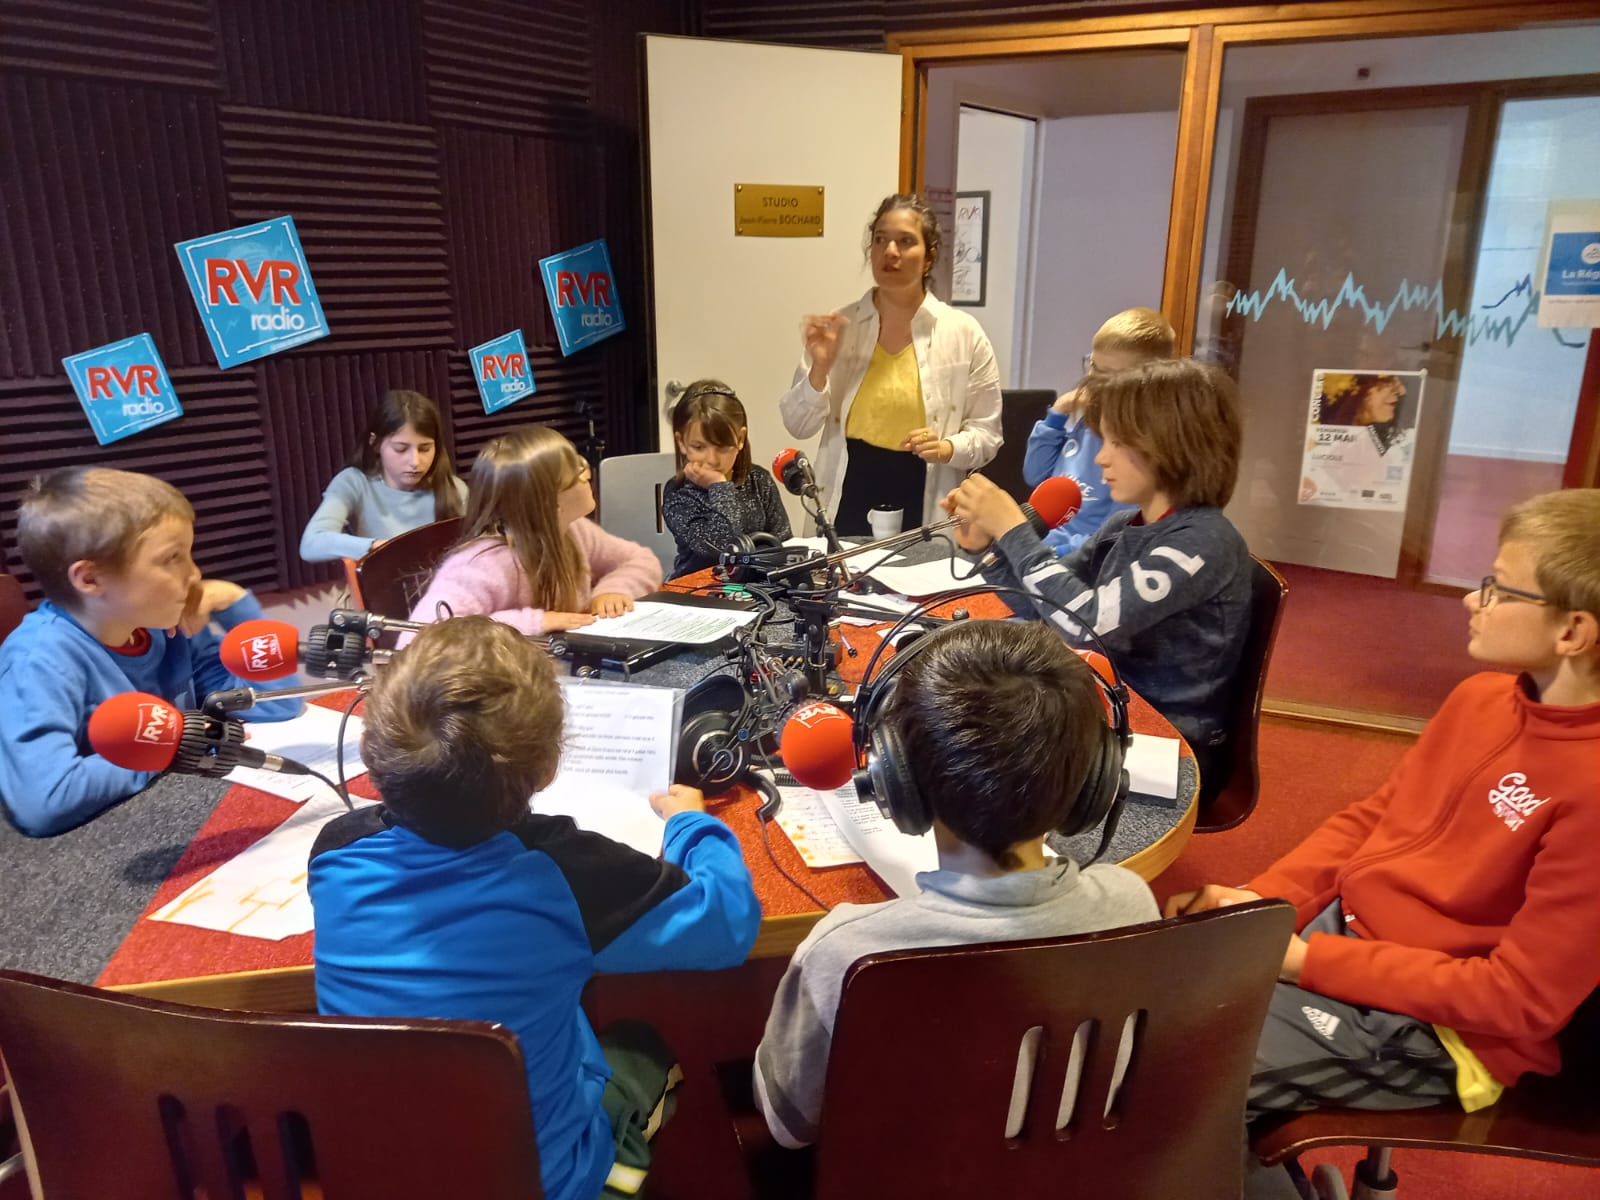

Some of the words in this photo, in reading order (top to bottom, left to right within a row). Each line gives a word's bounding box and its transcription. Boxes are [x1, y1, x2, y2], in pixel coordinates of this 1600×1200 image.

[762, 197, 799, 208] STUDIO
[778, 215, 821, 225] BOCHARD
[204, 258, 303, 306] RVR
[555, 271, 612, 308] RVR
[250, 305, 306, 331] radio
[580, 307, 613, 327] radio
[481, 353, 526, 381] RVR
[86, 364, 162, 401] RVR
[500, 378, 526, 393] radio
[122, 395, 165, 416] radio
[1318, 433, 1332, 442] 12
[251, 637, 270, 670] RVR
[142, 704, 169, 742] RVR
[1488, 772, 1552, 817] Good
